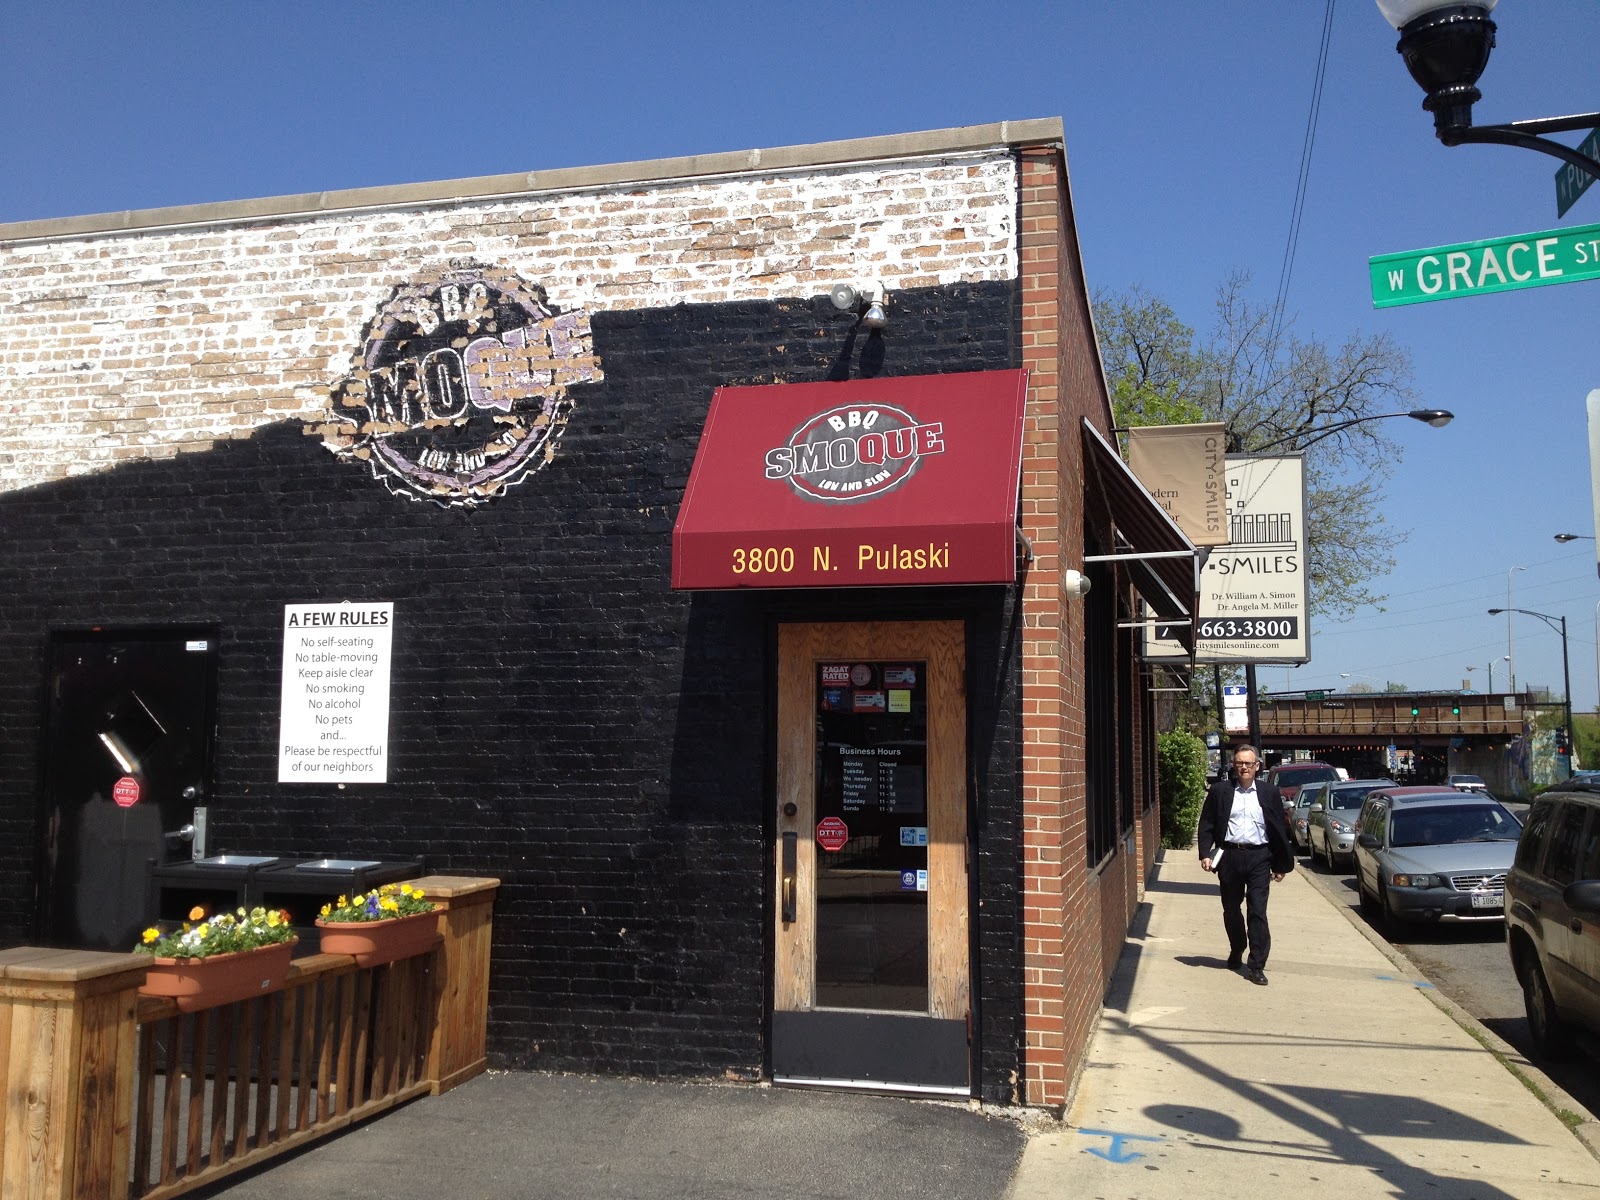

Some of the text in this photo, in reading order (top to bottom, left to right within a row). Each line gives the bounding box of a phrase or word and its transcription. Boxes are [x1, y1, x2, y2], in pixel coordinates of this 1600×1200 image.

[1388, 269, 1404, 291] W
[1416, 237, 1563, 294] GRACE
[827, 410, 879, 432] BBQ
[765, 422, 945, 479] SMOQUE
[818, 469, 892, 492] LOW AND SLOW
[732, 542, 949, 574] 3800 N. Pulaski
[1218, 556, 1298, 575] SMILES
[1225, 592, 1258, 600] William
[1260, 592, 1268, 600] A.
[1269, 591, 1296, 599] Simon
[1217, 601, 1299, 613] Dr. Angela M. Miller
[288, 611, 389, 626] A FEW RULES
[301, 636, 374, 648] No self-seating
[295, 652, 378, 664] No table-moving
[298, 667, 374, 679] Keep aisle clear
[306, 683, 365, 695] No smoking
[308, 698, 361, 709] No alcohol
[315, 715, 353, 726] No pets
[320, 730, 347, 740] and...
[284, 745, 382, 758] Please be respectful
[840, 747, 901, 756] Business Hours
[291, 761, 374, 774] of our neighbors
